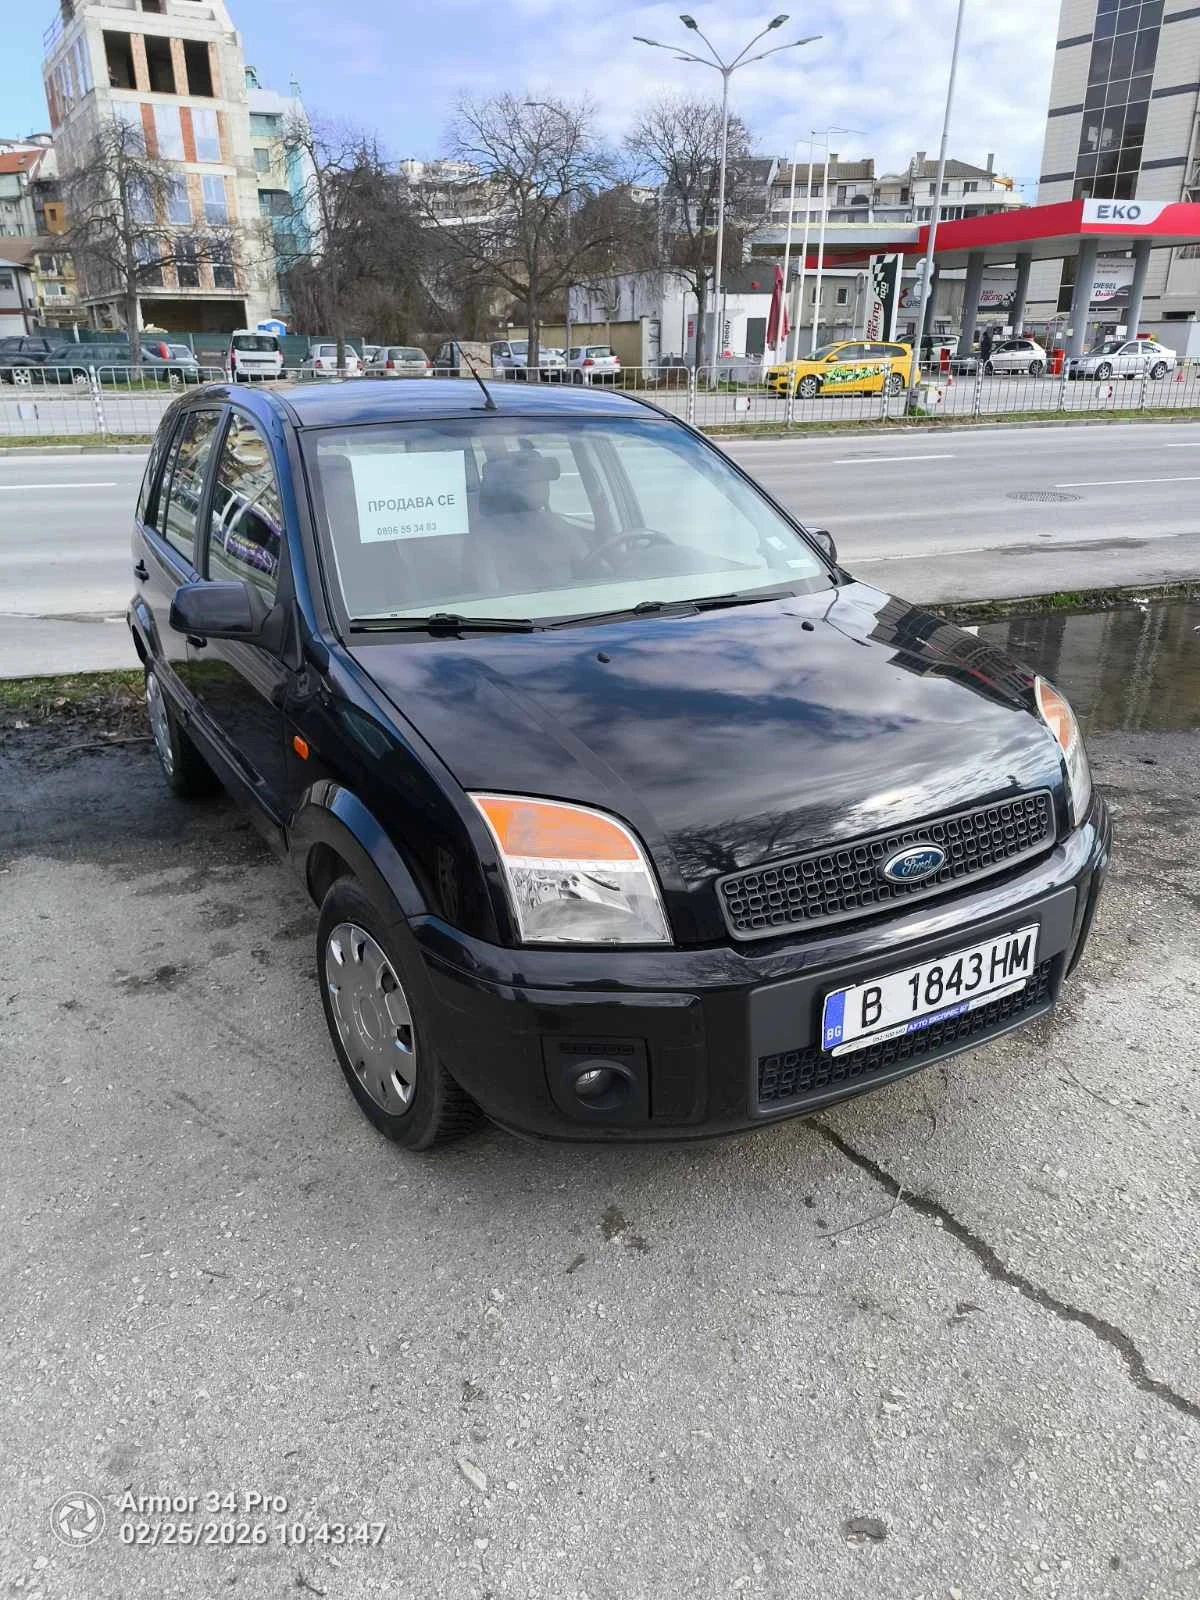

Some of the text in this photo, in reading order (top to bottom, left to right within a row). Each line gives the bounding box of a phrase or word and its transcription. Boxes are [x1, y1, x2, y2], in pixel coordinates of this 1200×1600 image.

[1097, 204, 1141, 220] EKO
[1093, 282, 1117, 290] DIESEL
[368, 494, 455, 512] ПРОДАВА СЕ
[902, 853, 934, 877] Ford
[861, 934, 1031, 1028] B 1843 HM
[826, 1025, 842, 1040] BG
